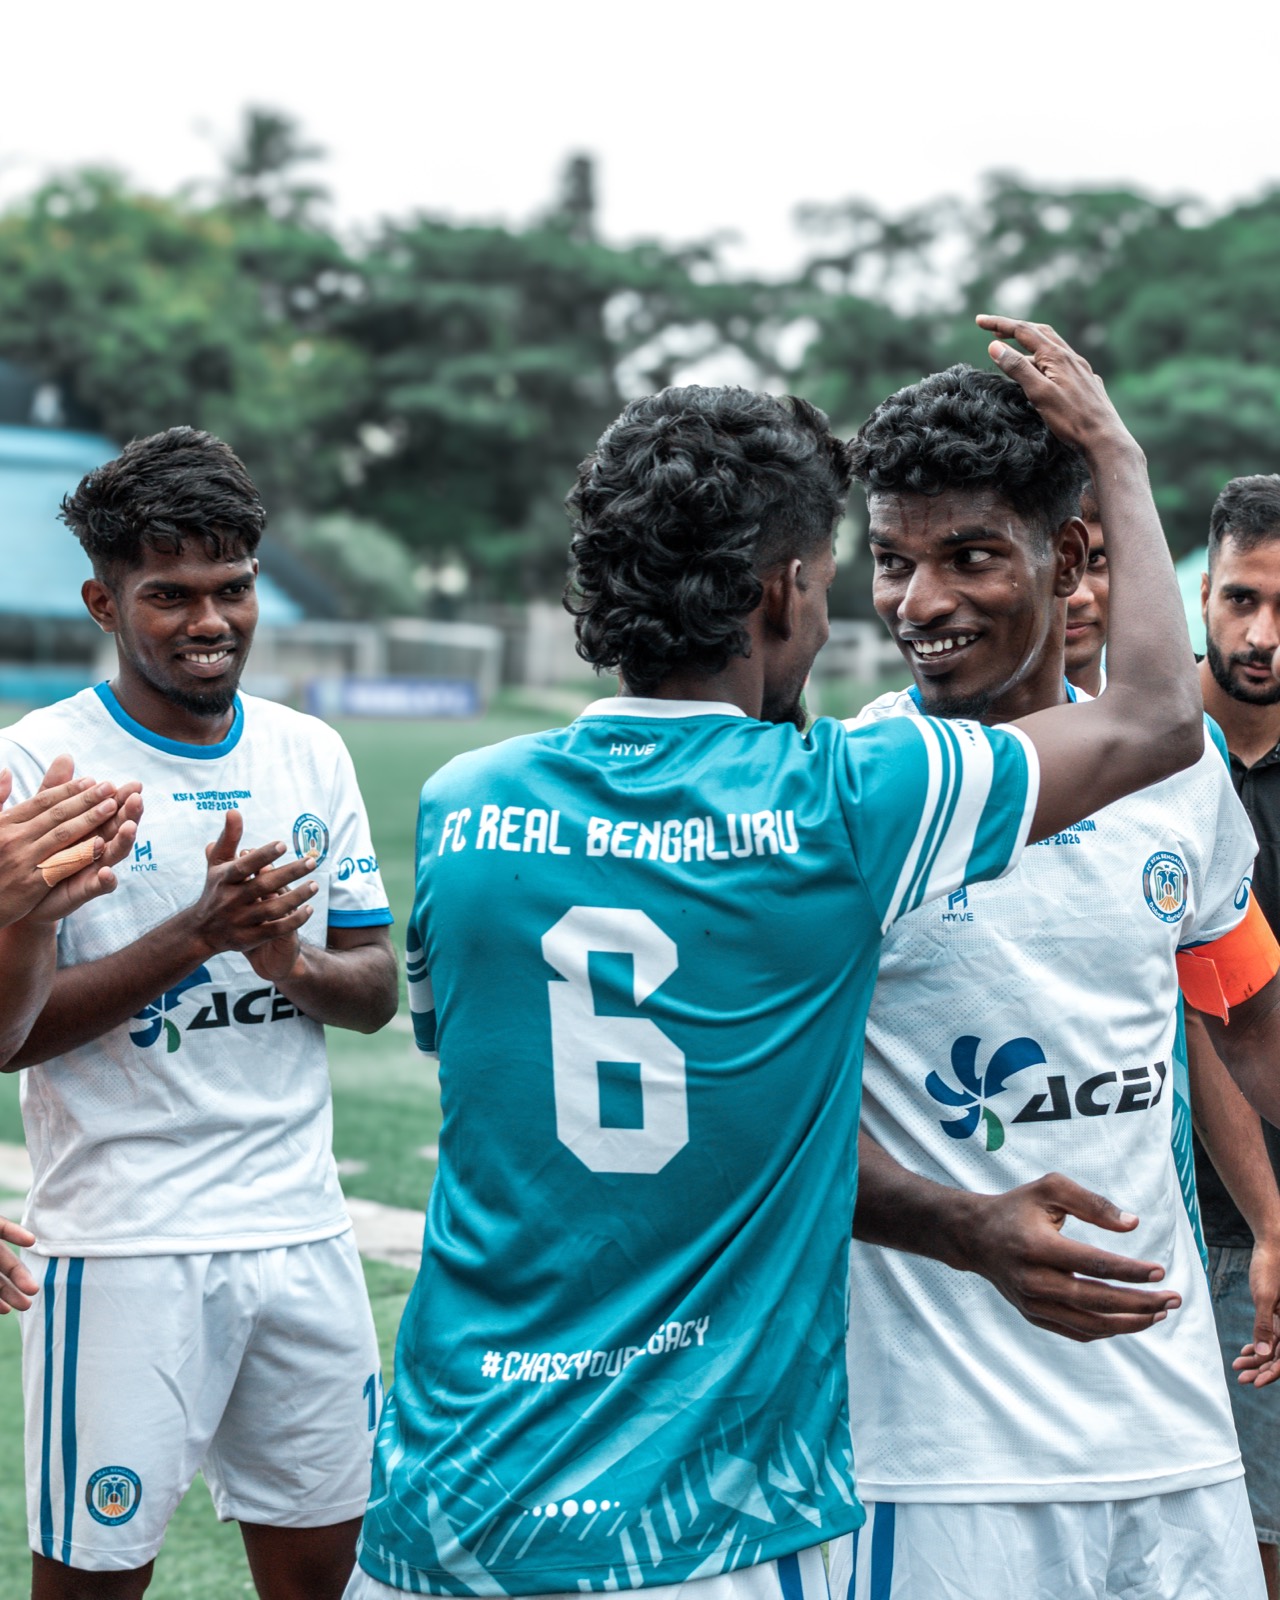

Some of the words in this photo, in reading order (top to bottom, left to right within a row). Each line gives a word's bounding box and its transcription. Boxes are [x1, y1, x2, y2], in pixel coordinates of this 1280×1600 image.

[609, 743, 657, 757] HYVE
[172, 793, 196, 802] KSFA
[218, 789, 252, 801] DIVISION
[438, 808, 472, 857] FC
[475, 804, 572, 855] REAL
[586, 809, 800, 864] BENGALURU
[131, 863, 158, 872] HYVE
[942, 912, 974, 922] HYVE
[185, 985, 305, 1031] ACE
[540, 905, 690, 1174] 6
